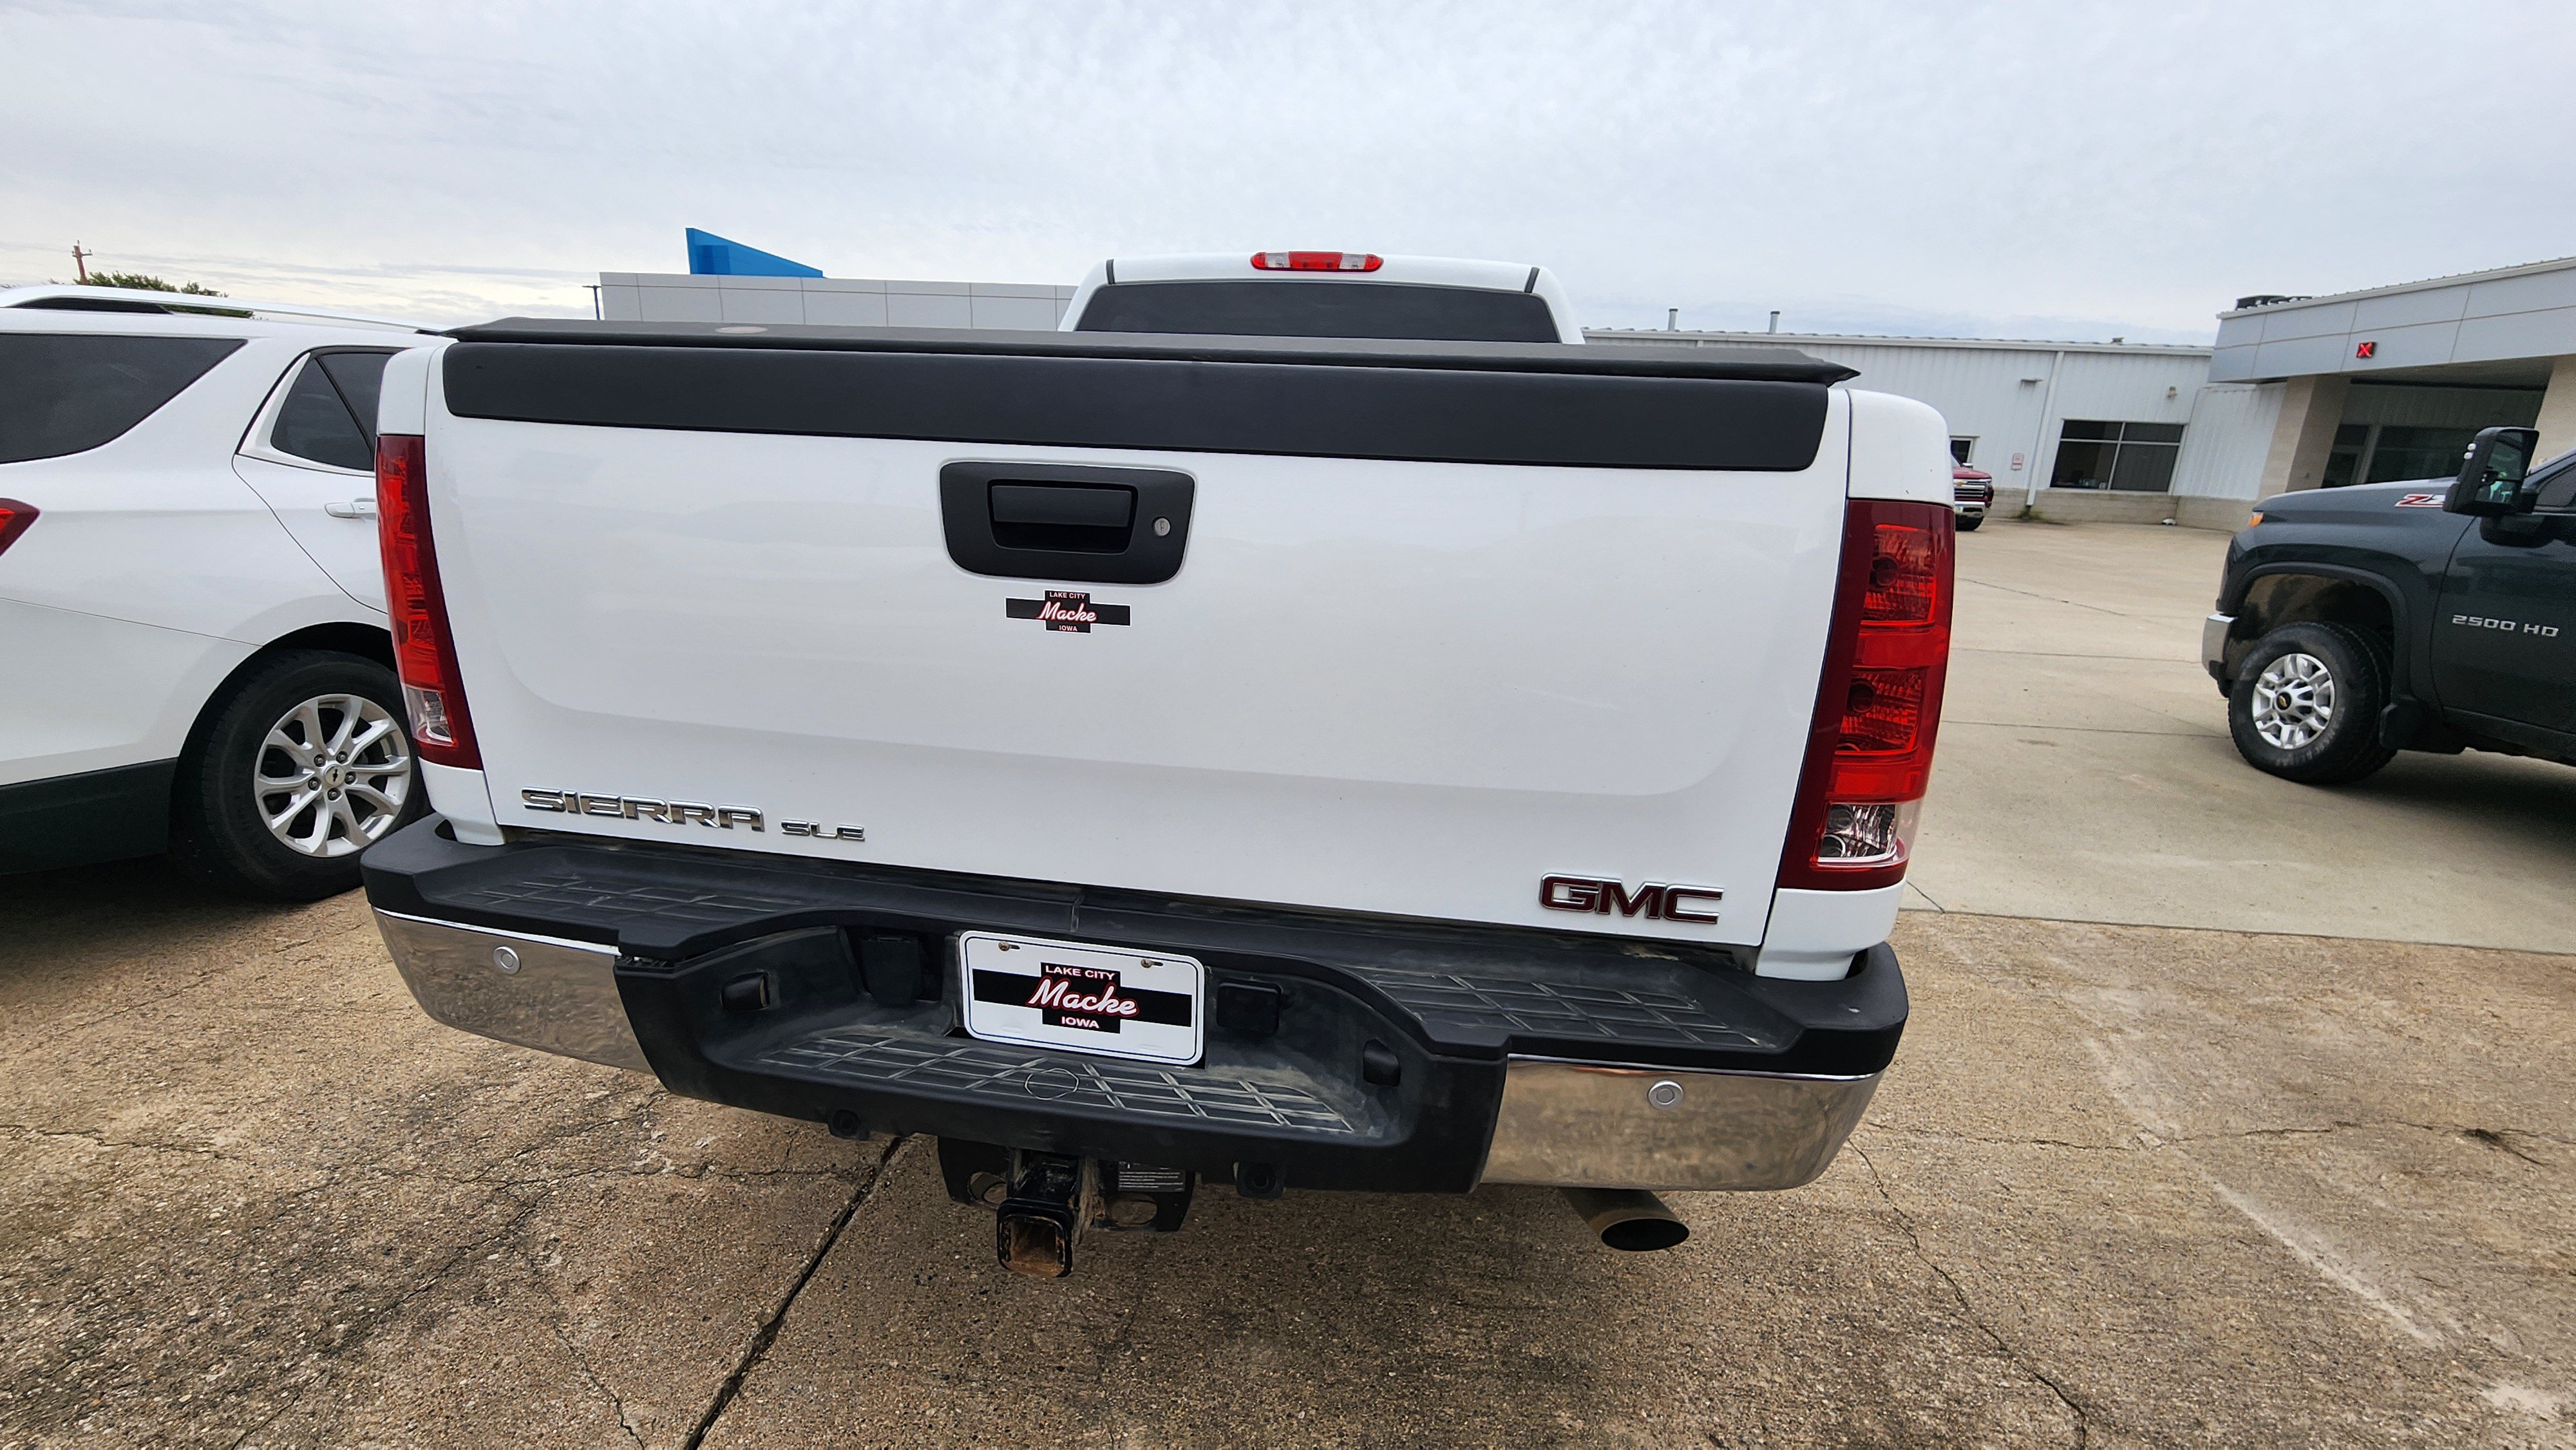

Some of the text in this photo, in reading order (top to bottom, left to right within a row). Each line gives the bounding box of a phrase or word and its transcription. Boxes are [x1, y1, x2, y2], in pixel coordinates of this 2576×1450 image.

[1037, 601, 1097, 622] Macke
[2452, 614, 2559, 637] 2500 HD
[521, 786, 866, 842] SIERRA SLE
[1539, 872, 1725, 924] GMC
[1045, 965, 1115, 981] LAKE CITY
[1027, 978, 1138, 1015] Macke
[1061, 1016, 1100, 1029] IOWA
